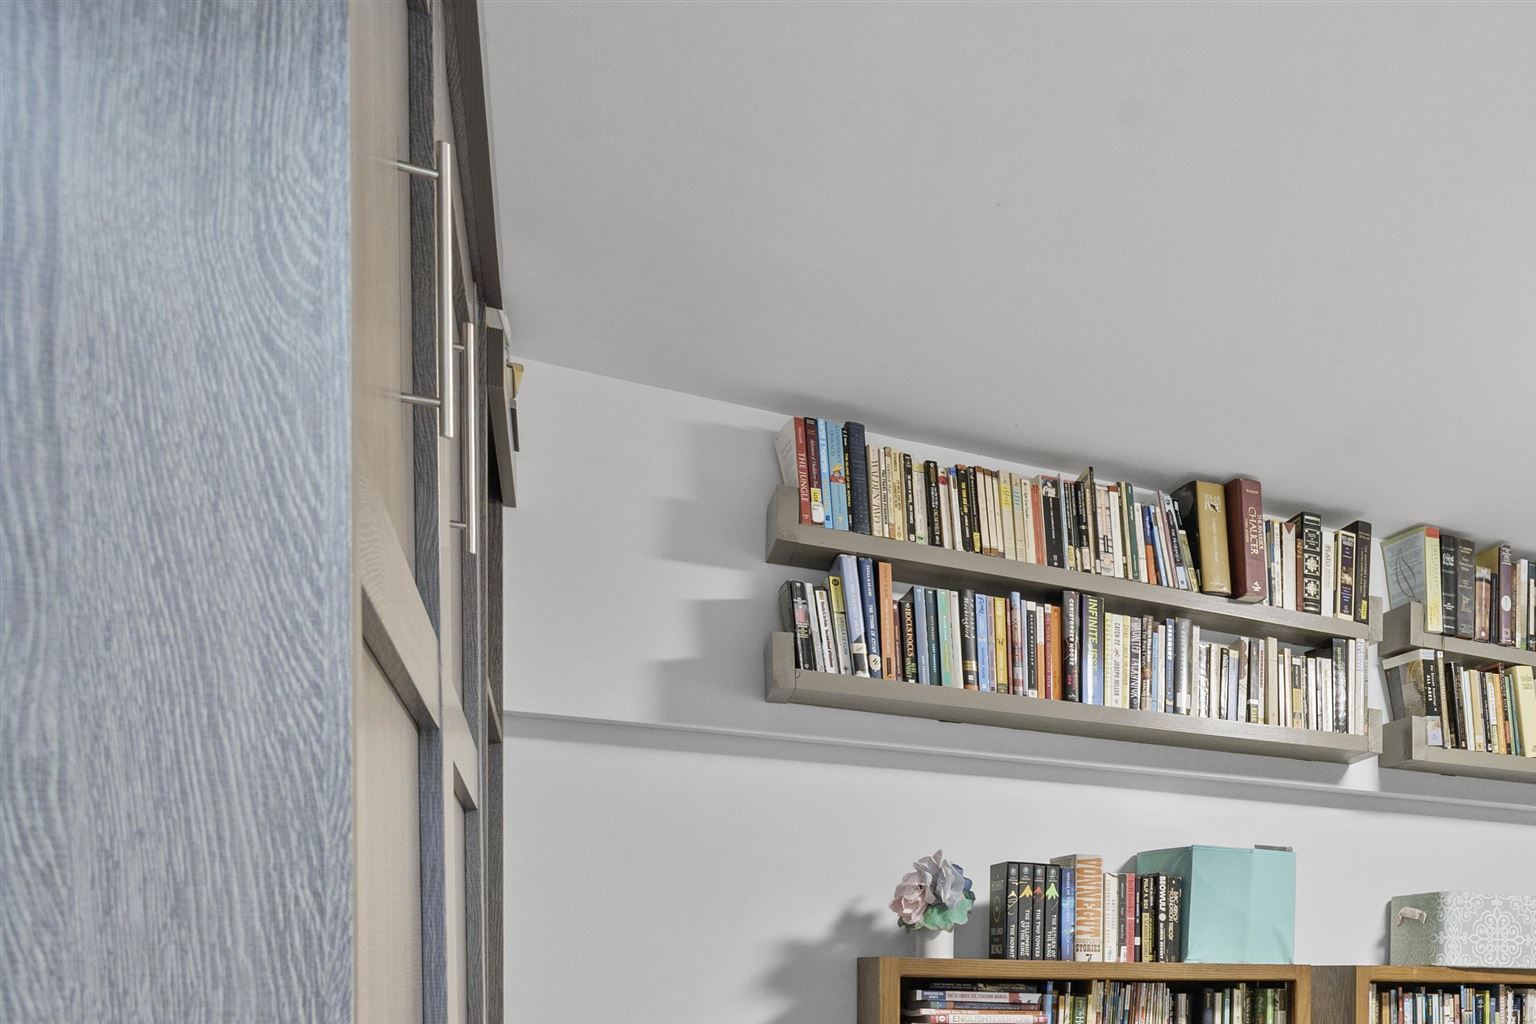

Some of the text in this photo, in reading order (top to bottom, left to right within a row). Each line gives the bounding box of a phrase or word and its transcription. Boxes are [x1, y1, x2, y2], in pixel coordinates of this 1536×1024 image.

[799, 471, 808, 502] JUNGLE
[1248, 506, 1259, 555] CHAUCER
[905, 608, 913, 633] HOCUS
[1088, 598, 1098, 645] INFINITE
[1076, 858, 1102, 938] VONNEGUT
